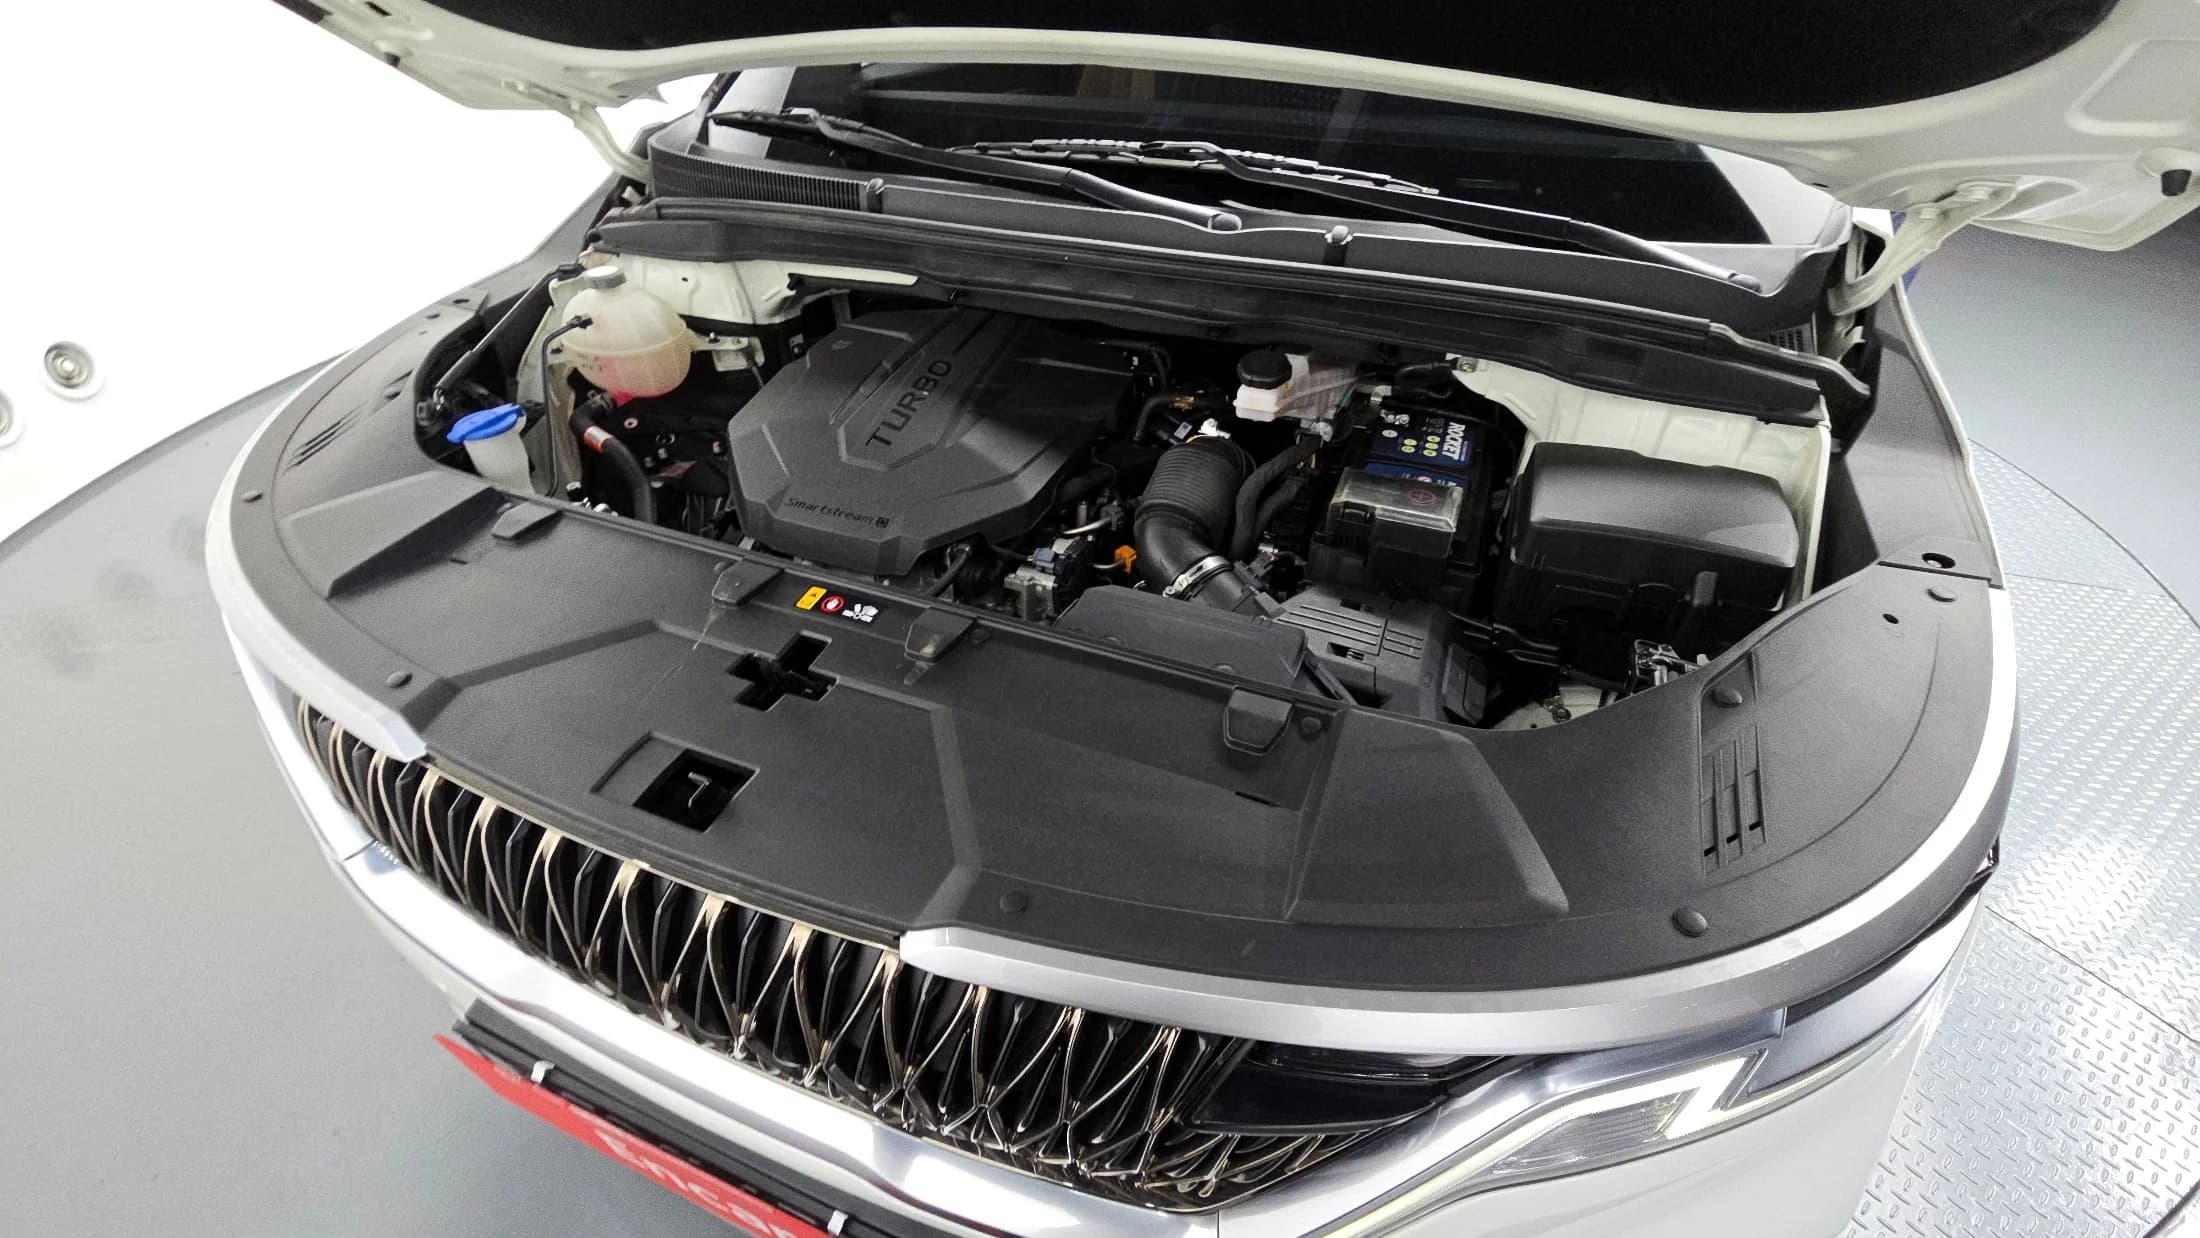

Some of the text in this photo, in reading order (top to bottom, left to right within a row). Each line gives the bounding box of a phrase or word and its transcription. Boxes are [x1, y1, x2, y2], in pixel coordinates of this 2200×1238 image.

[865, 360, 952, 447] TURBO
[1442, 421, 1466, 460] ROCKET
[785, 498, 875, 525] Smartstream
